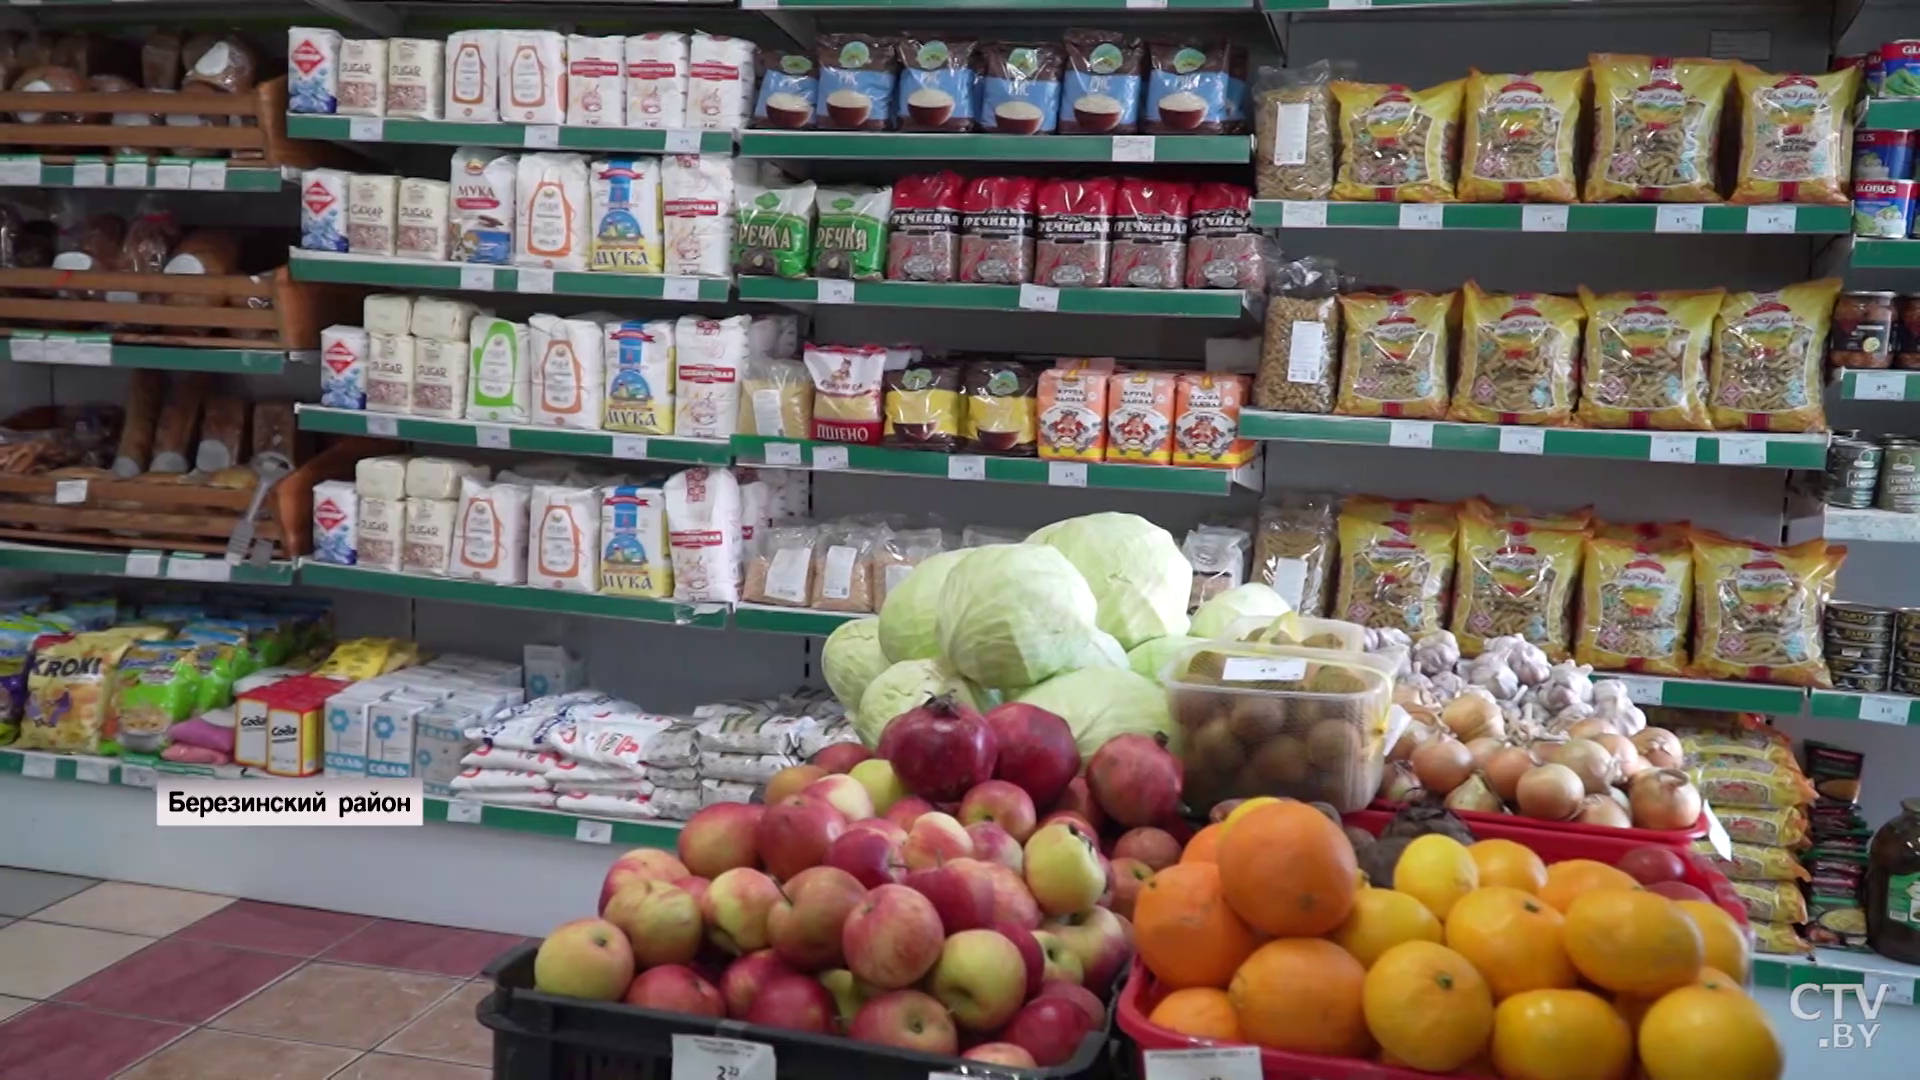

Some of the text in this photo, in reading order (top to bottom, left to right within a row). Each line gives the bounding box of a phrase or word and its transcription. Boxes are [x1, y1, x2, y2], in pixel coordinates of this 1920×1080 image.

[458, 185, 496, 198] МУКА
[816, 424, 869, 442] ПШЕНО
[271, 725, 297, 737] Сода
